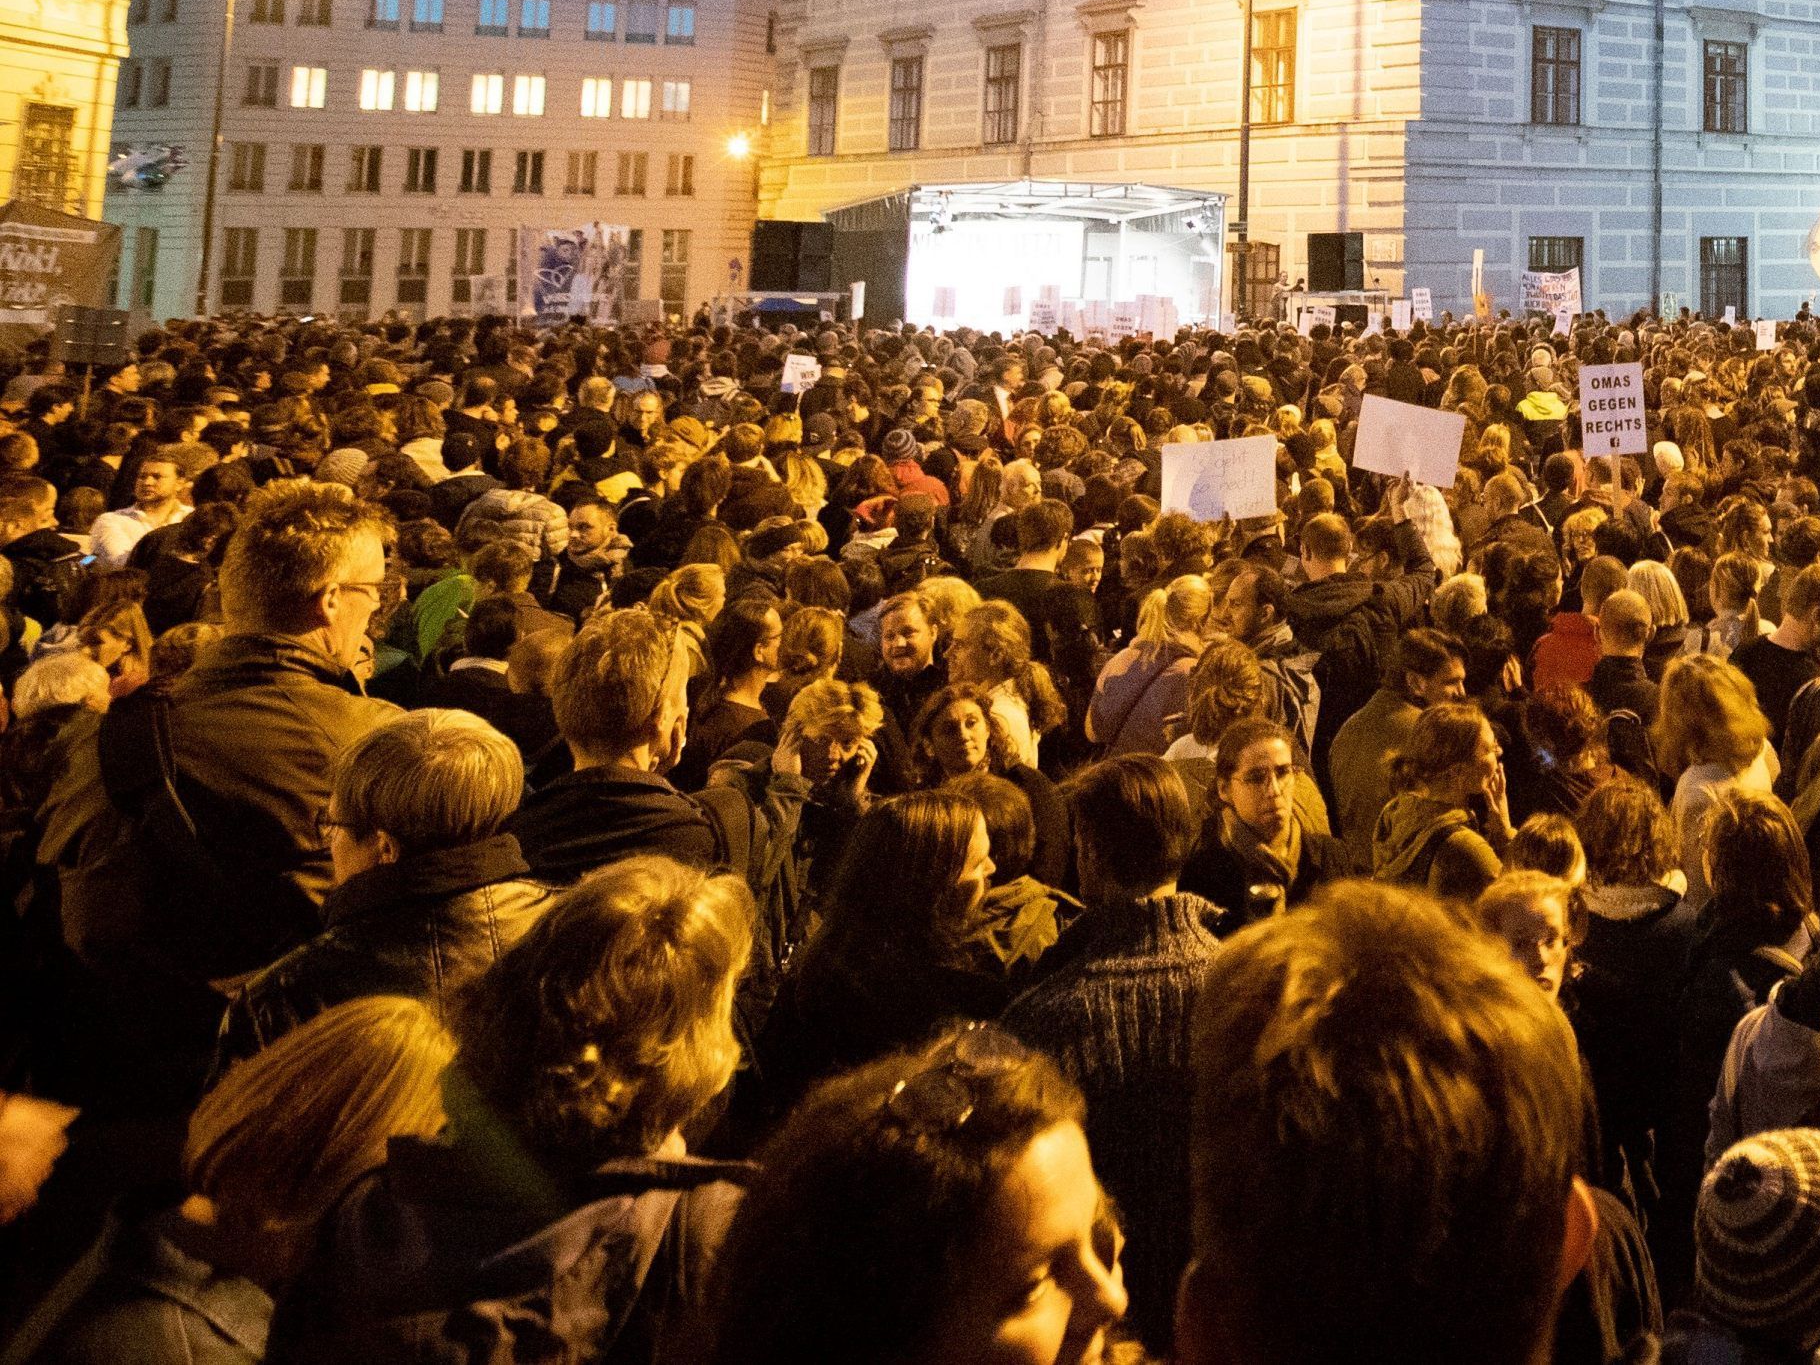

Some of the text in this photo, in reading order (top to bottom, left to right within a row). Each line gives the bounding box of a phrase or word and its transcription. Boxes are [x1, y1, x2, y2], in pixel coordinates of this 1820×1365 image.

[1591, 375, 1631, 389] OMAS
[1588, 397, 1636, 411] GEGEN
[1585, 418, 1642, 433] RECHTS
